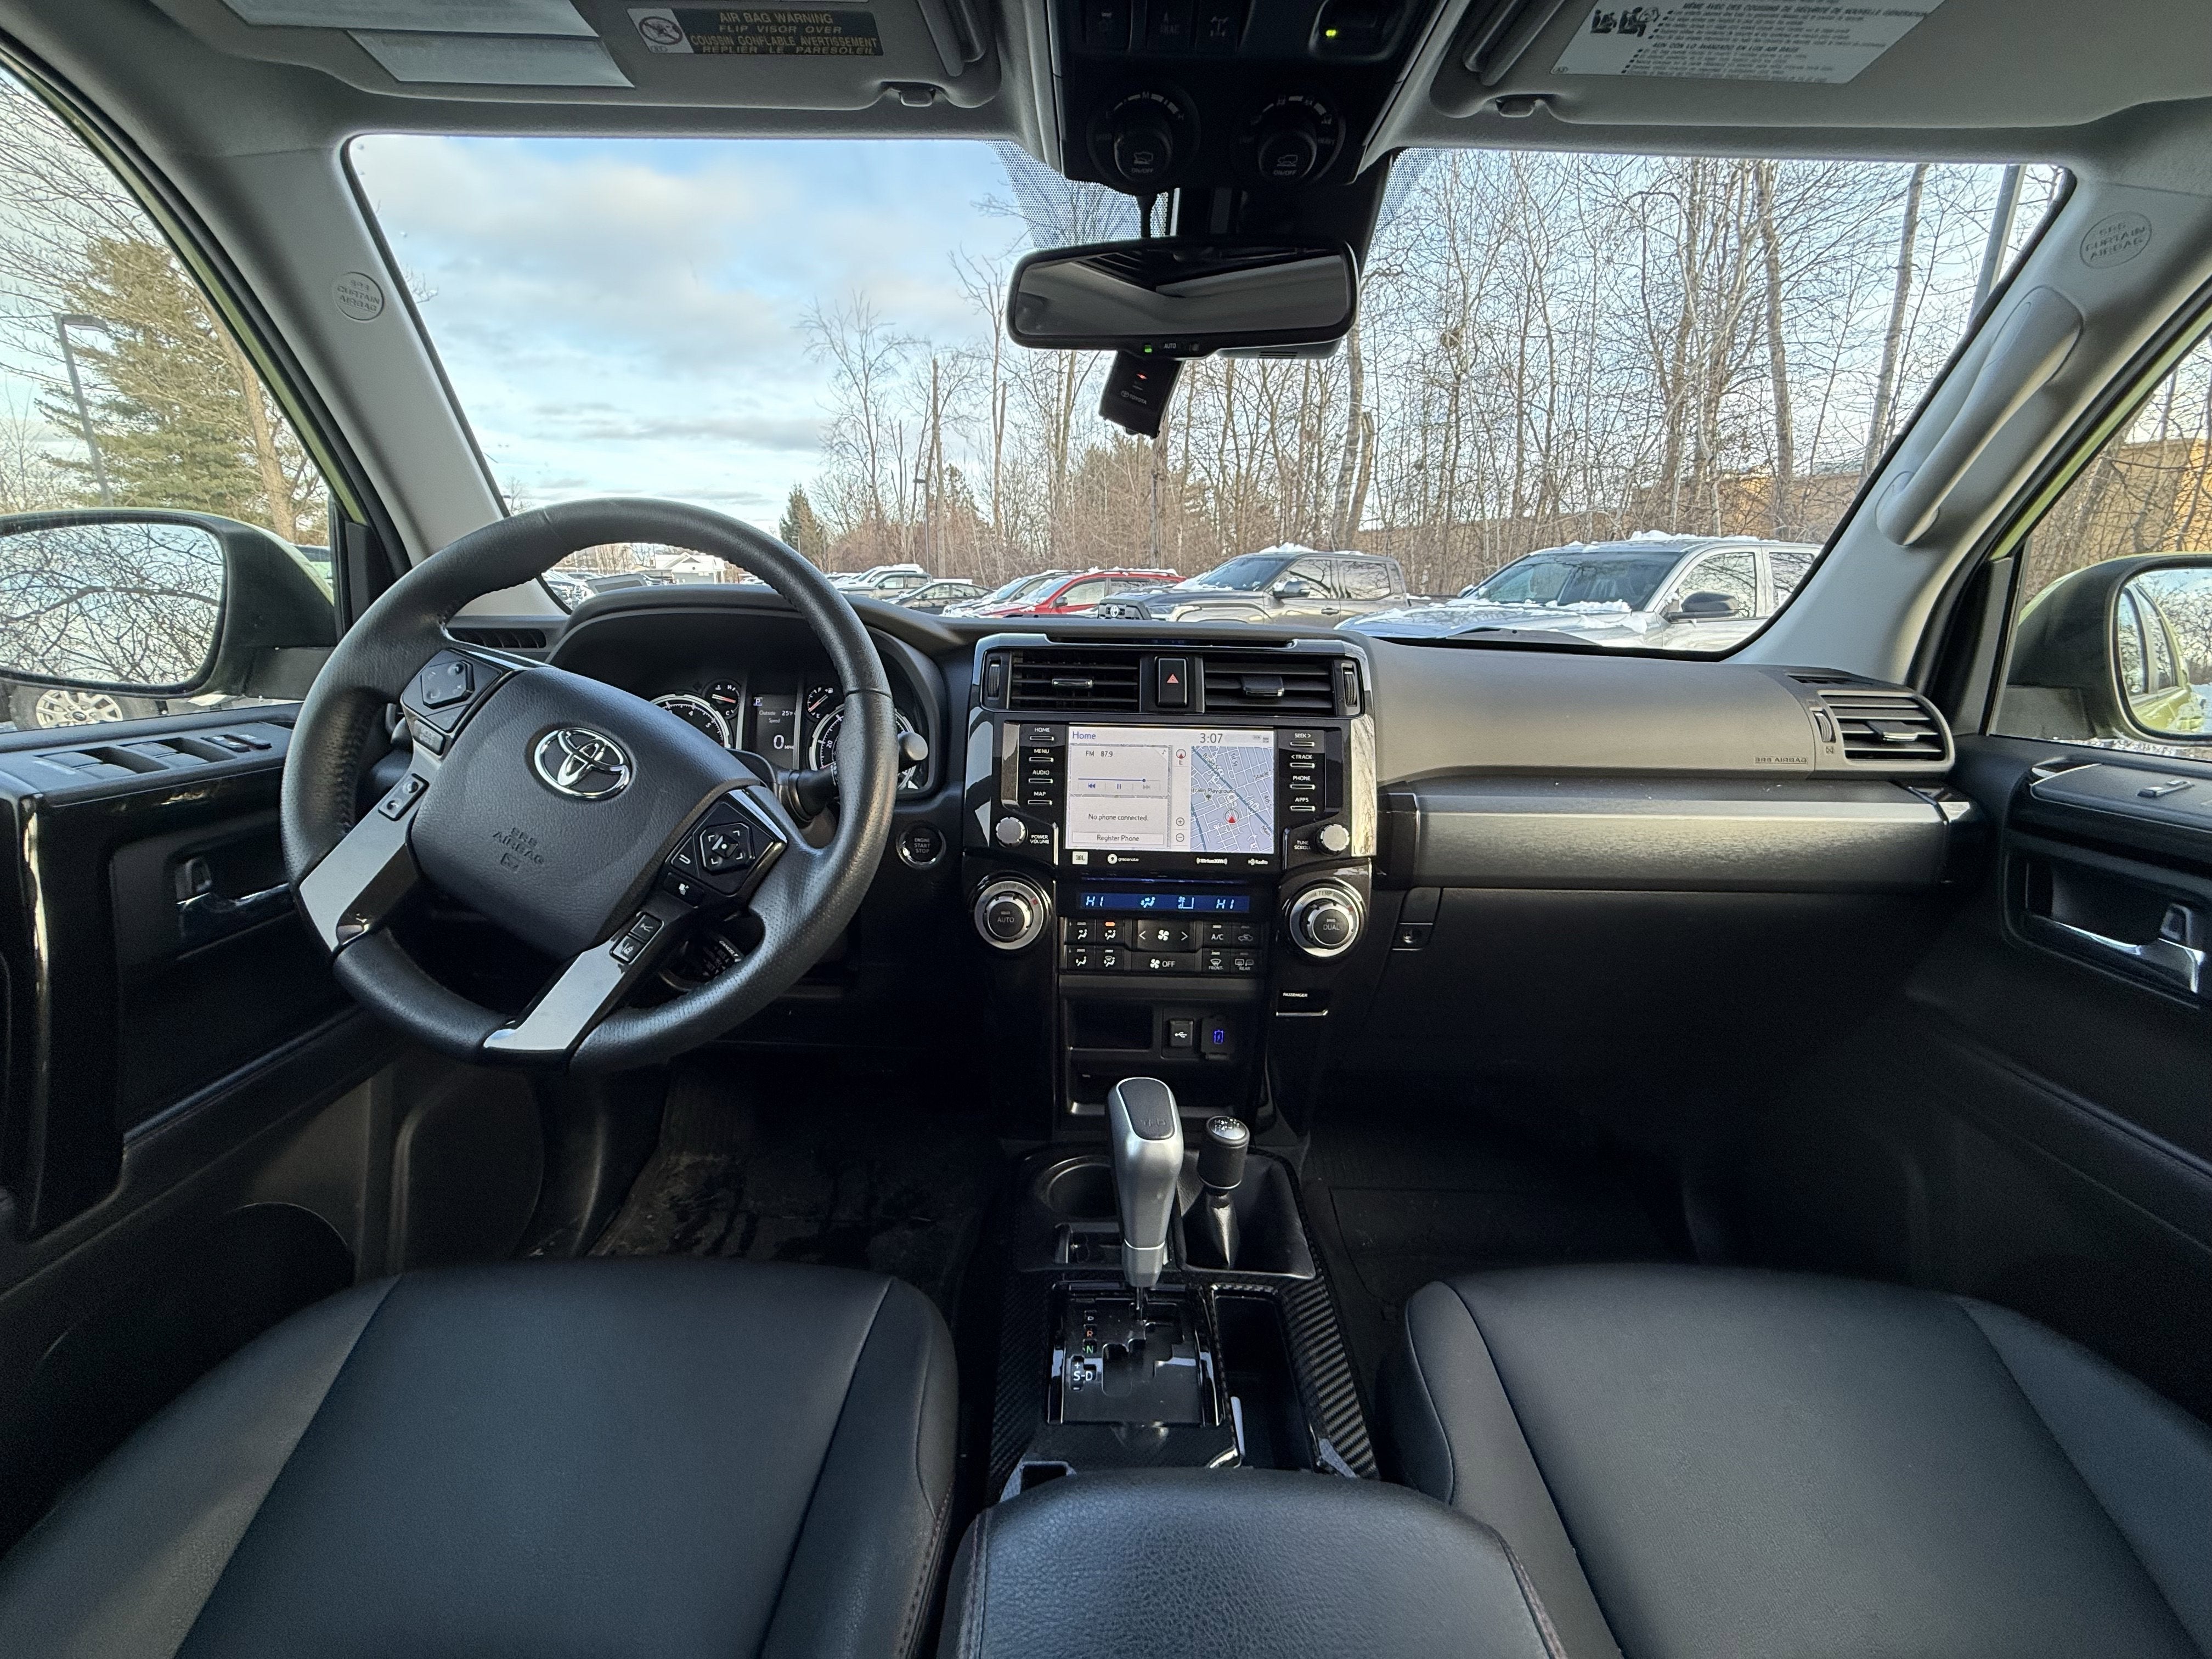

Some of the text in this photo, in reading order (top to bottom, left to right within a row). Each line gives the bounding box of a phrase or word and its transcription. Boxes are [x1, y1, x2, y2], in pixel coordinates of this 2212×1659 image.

[720, 12, 833, 24] AIR BAG WARNING
[805, 25, 842, 33] OVER
[690, 35, 735, 45] COUSSIN
[800, 36, 877, 47] AVERTISSEMENT
[703, 46, 758, 54] REPLIER
[796, 47, 874, 55] PARESOLEIL
[337, 285, 380, 305] CURTAIN
[340, 295, 377, 312] AIRBAG
[1129, 394, 1148, 405] TOYOTA
[1073, 731, 1096, 740] Home
[1200, 733, 1223, 744] 3:07
[773, 735, 785, 749] 0
[826, 740, 833, 749] 20
[492, 831, 545, 865] AIRBAG
[1086, 1345, 1093, 1353] N
